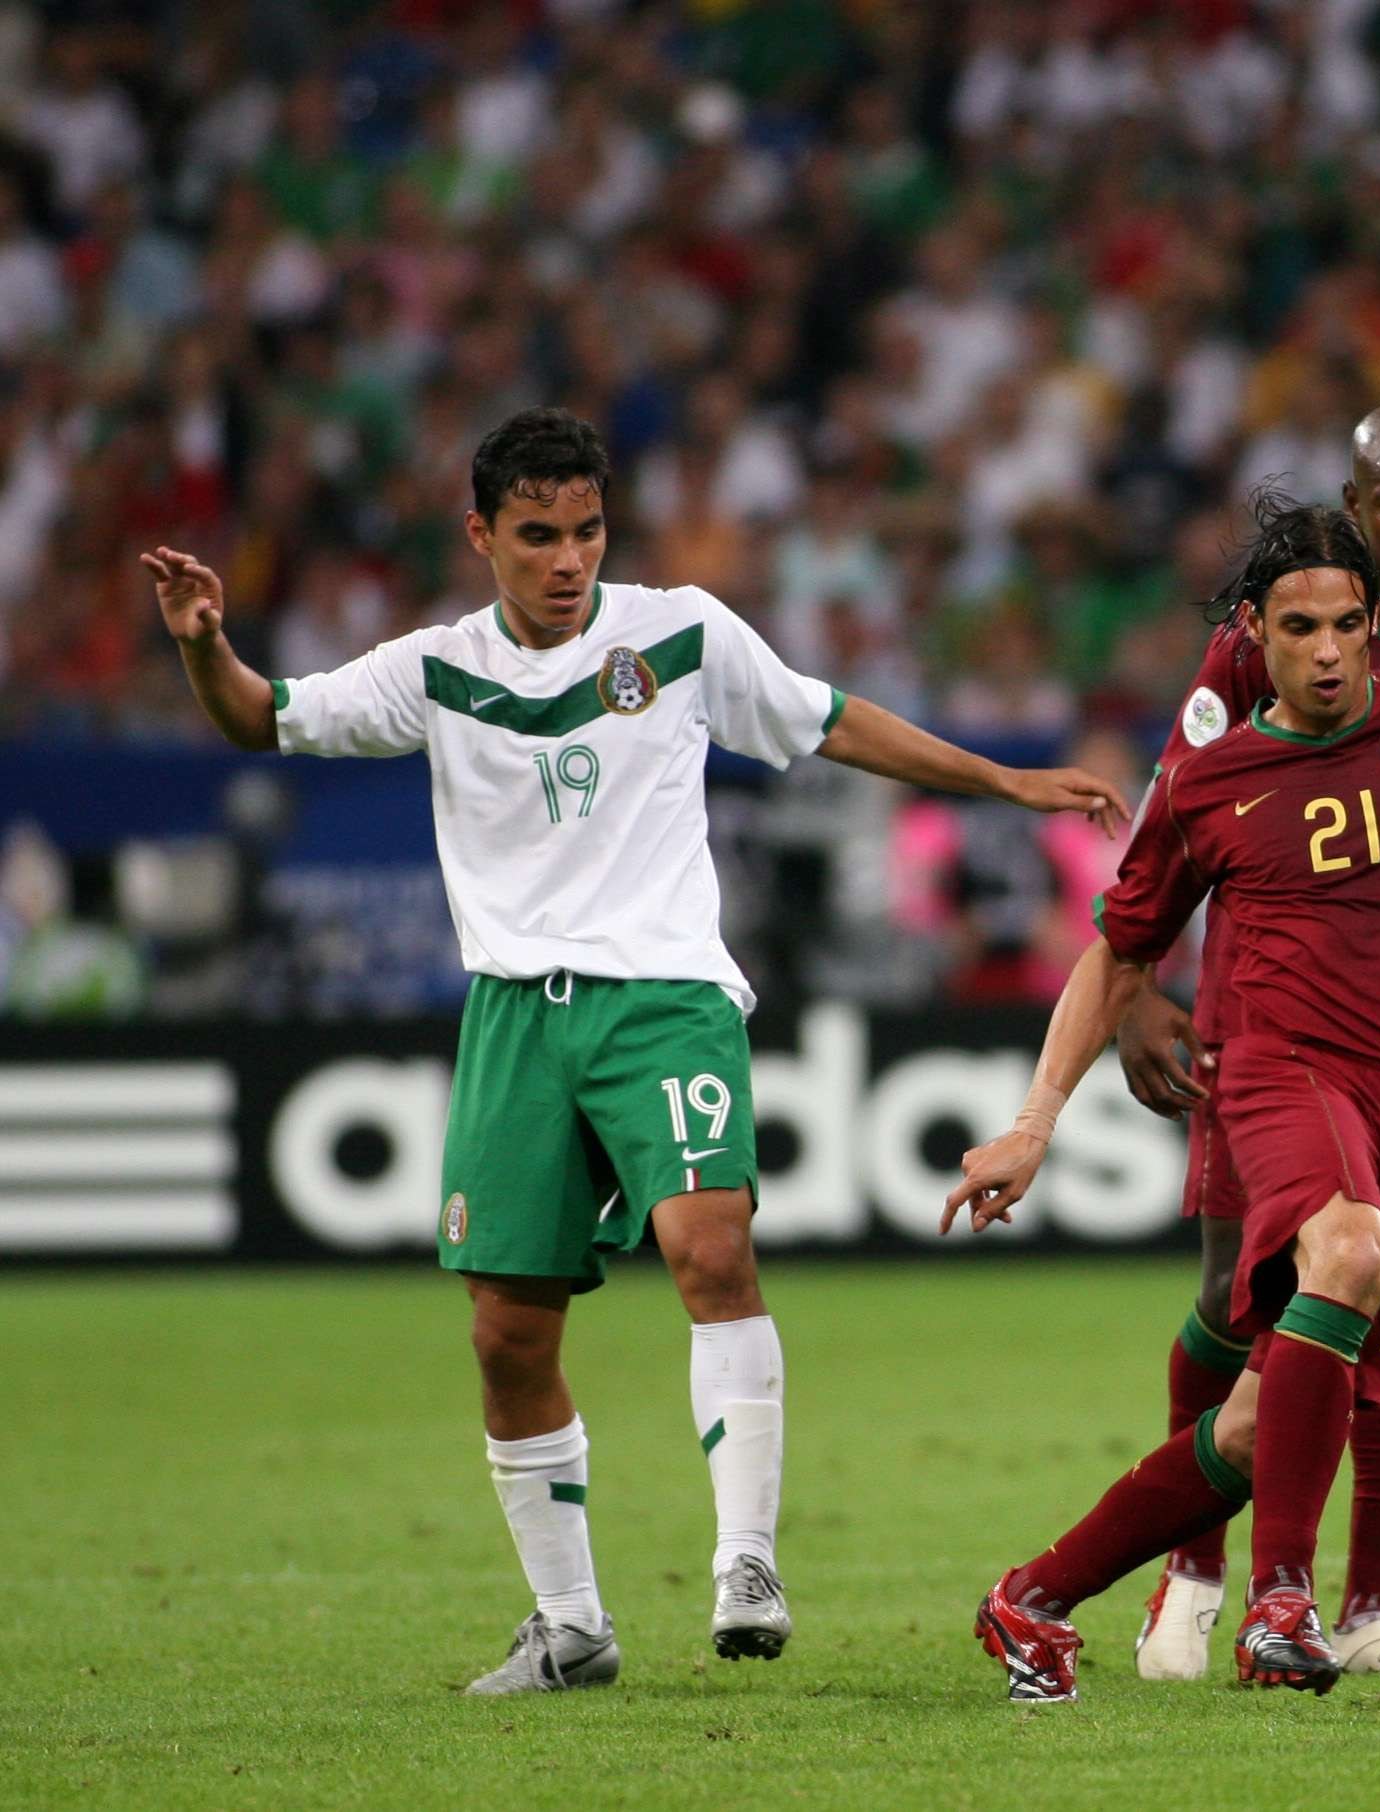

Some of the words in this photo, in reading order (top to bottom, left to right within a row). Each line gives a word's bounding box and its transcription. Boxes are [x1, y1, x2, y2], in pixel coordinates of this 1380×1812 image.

[532, 743, 601, 824] 19
[267, 1007, 1190, 1248] adas
[660, 1072, 732, 1142] 19
